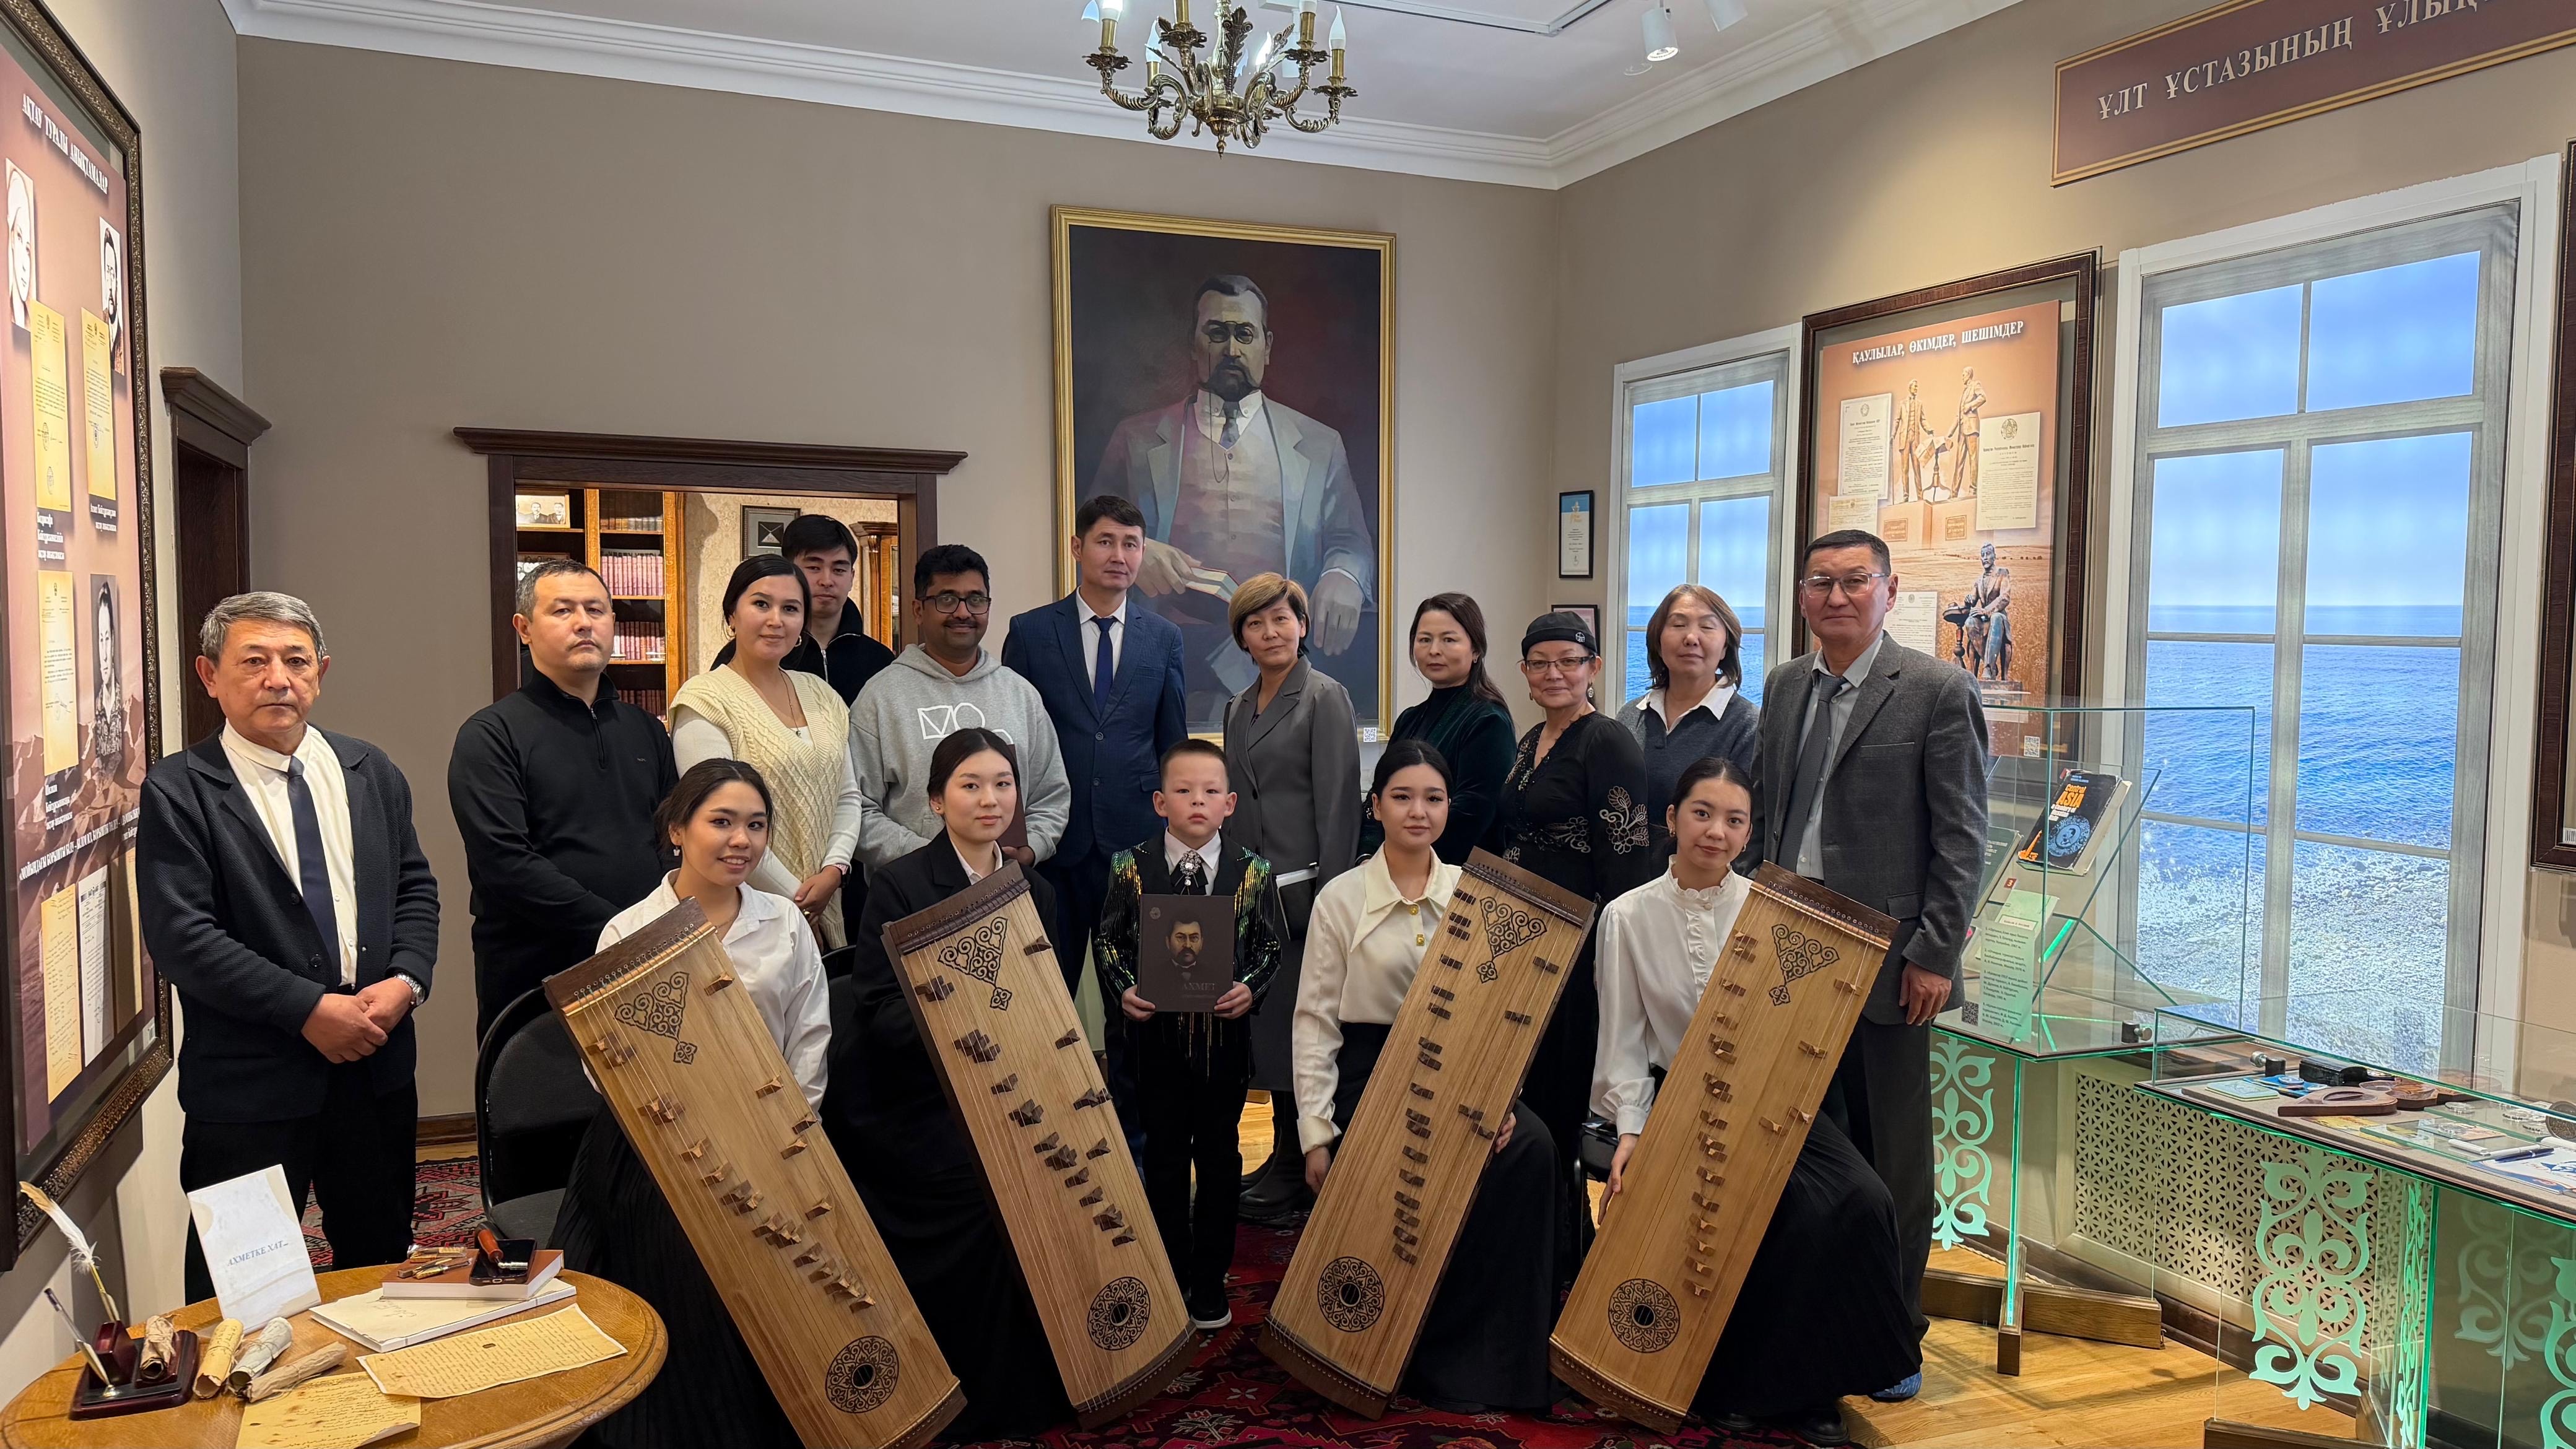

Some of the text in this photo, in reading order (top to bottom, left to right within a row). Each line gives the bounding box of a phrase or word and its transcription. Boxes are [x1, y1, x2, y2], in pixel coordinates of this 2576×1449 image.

[2098, 82, 2148, 120] ҰЛТ
[2165, 16, 2354, 99] ҰСТАЗЫНЫҢ
[44, 115, 69, 155] ТУРАЛЫ
[1852, 321, 2024, 364] ҚАУЛЫЛАР, ӨКІМДЕР, ШЕШІМДЕР
[2056, 791, 2084, 808] ASIA
[227, 1247, 266, 1266] АХМЕТКЕ
